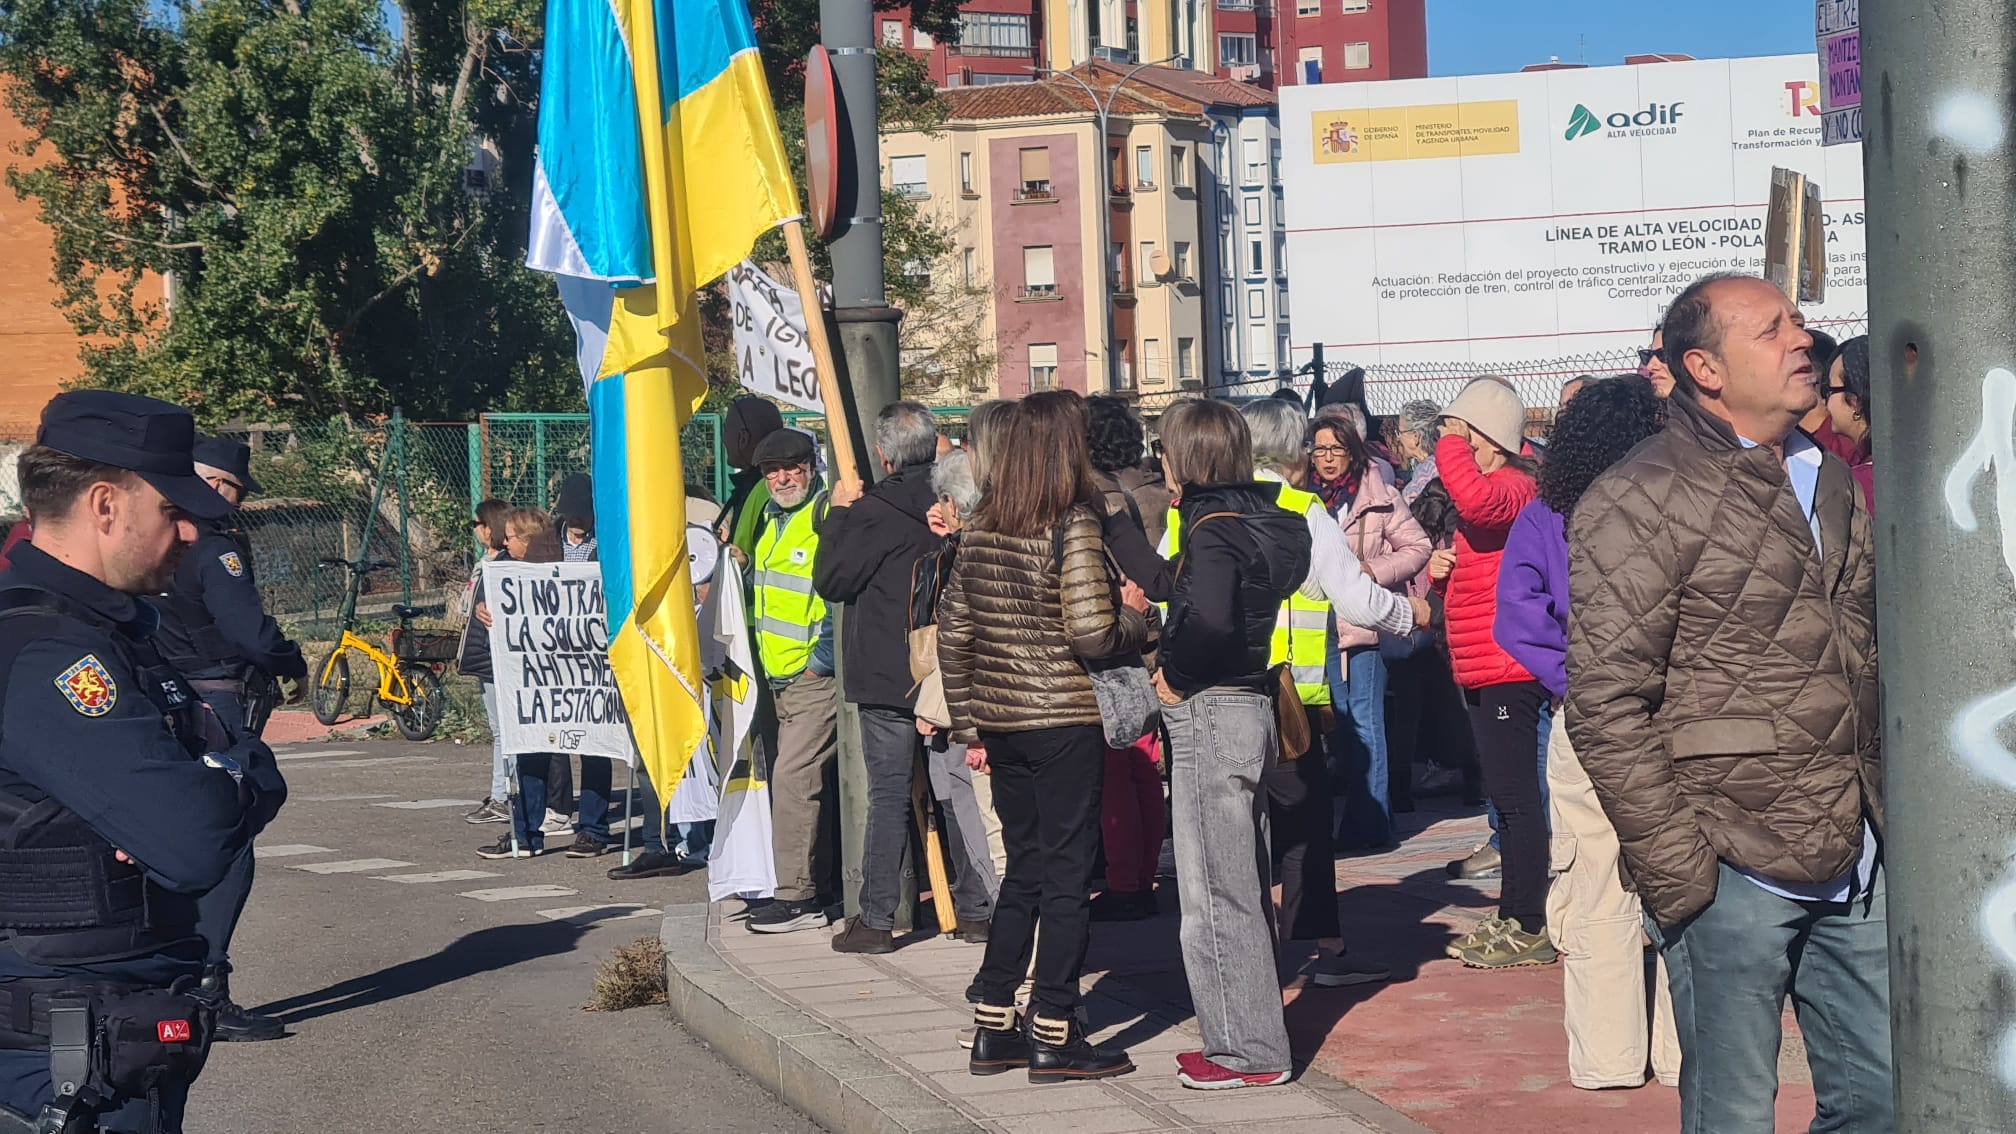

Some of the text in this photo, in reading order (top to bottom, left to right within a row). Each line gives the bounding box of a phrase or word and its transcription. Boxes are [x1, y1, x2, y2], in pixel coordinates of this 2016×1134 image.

[1818, 4, 1831, 32] EL
[1415, 122, 1453, 130] MINISTERIO
[1606, 102, 1685, 128] adif
[1825, 115, 1831, 143] Y
[1836, 112, 1848, 140] NO
[1450, 135, 1479, 143] URBANA
[1473, 126, 1510, 134] MOVILIDAD
[1607, 127, 1677, 138] ALTA VELOCIDAD
[1748, 129, 1770, 137] Plan
[1772, 128, 1786, 136] de
[1732, 138, 1812, 149] Transformación
[1545, 225, 1593, 242] LÍNEA
[1597, 226, 1619, 239] DE
[1623, 223, 1664, 237] ALTA
[1668, 218, 1762, 234] VELOCIDAD
[1599, 240, 1657, 255] TRAMO
[1662, 234, 1706, 251] LEÓN
[1720, 235, 1764, 248] POLA
[1371, 275, 1435, 287] Actuación:
[1438, 270, 1501, 284] Redacción
[1505, 269, 1523, 280] del
[1526, 265, 1579, 281] proyecto
[1582, 262, 1655, 276] constructivo
[1658, 263, 1665, 273] y
[1669, 257, 1727, 272] ejecución
[1730, 255, 1746, 268] de
[1749, 255, 1766, 267] las
[1828, 252, 1846, 262] las
[1380, 288, 1396, 299] de
[1399, 284, 1461, 300] protección
[1464, 284, 1480, 295] de
[1483, 283, 1510, 294] tren,
[1513, 280, 1554, 292] control
[1558, 278, 1574, 289] de
[1577, 276, 1614, 288] tráfico
[1617, 272, 1692, 286] centralizado
[1608, 285, 1662, 299] Corredor
[735, 302, 753, 332] DE
[742, 345, 822, 401] A LEO
[531, 579, 560, 616] NO
[505, 616, 538, 652] LA
[516, 688, 547, 724] LA
